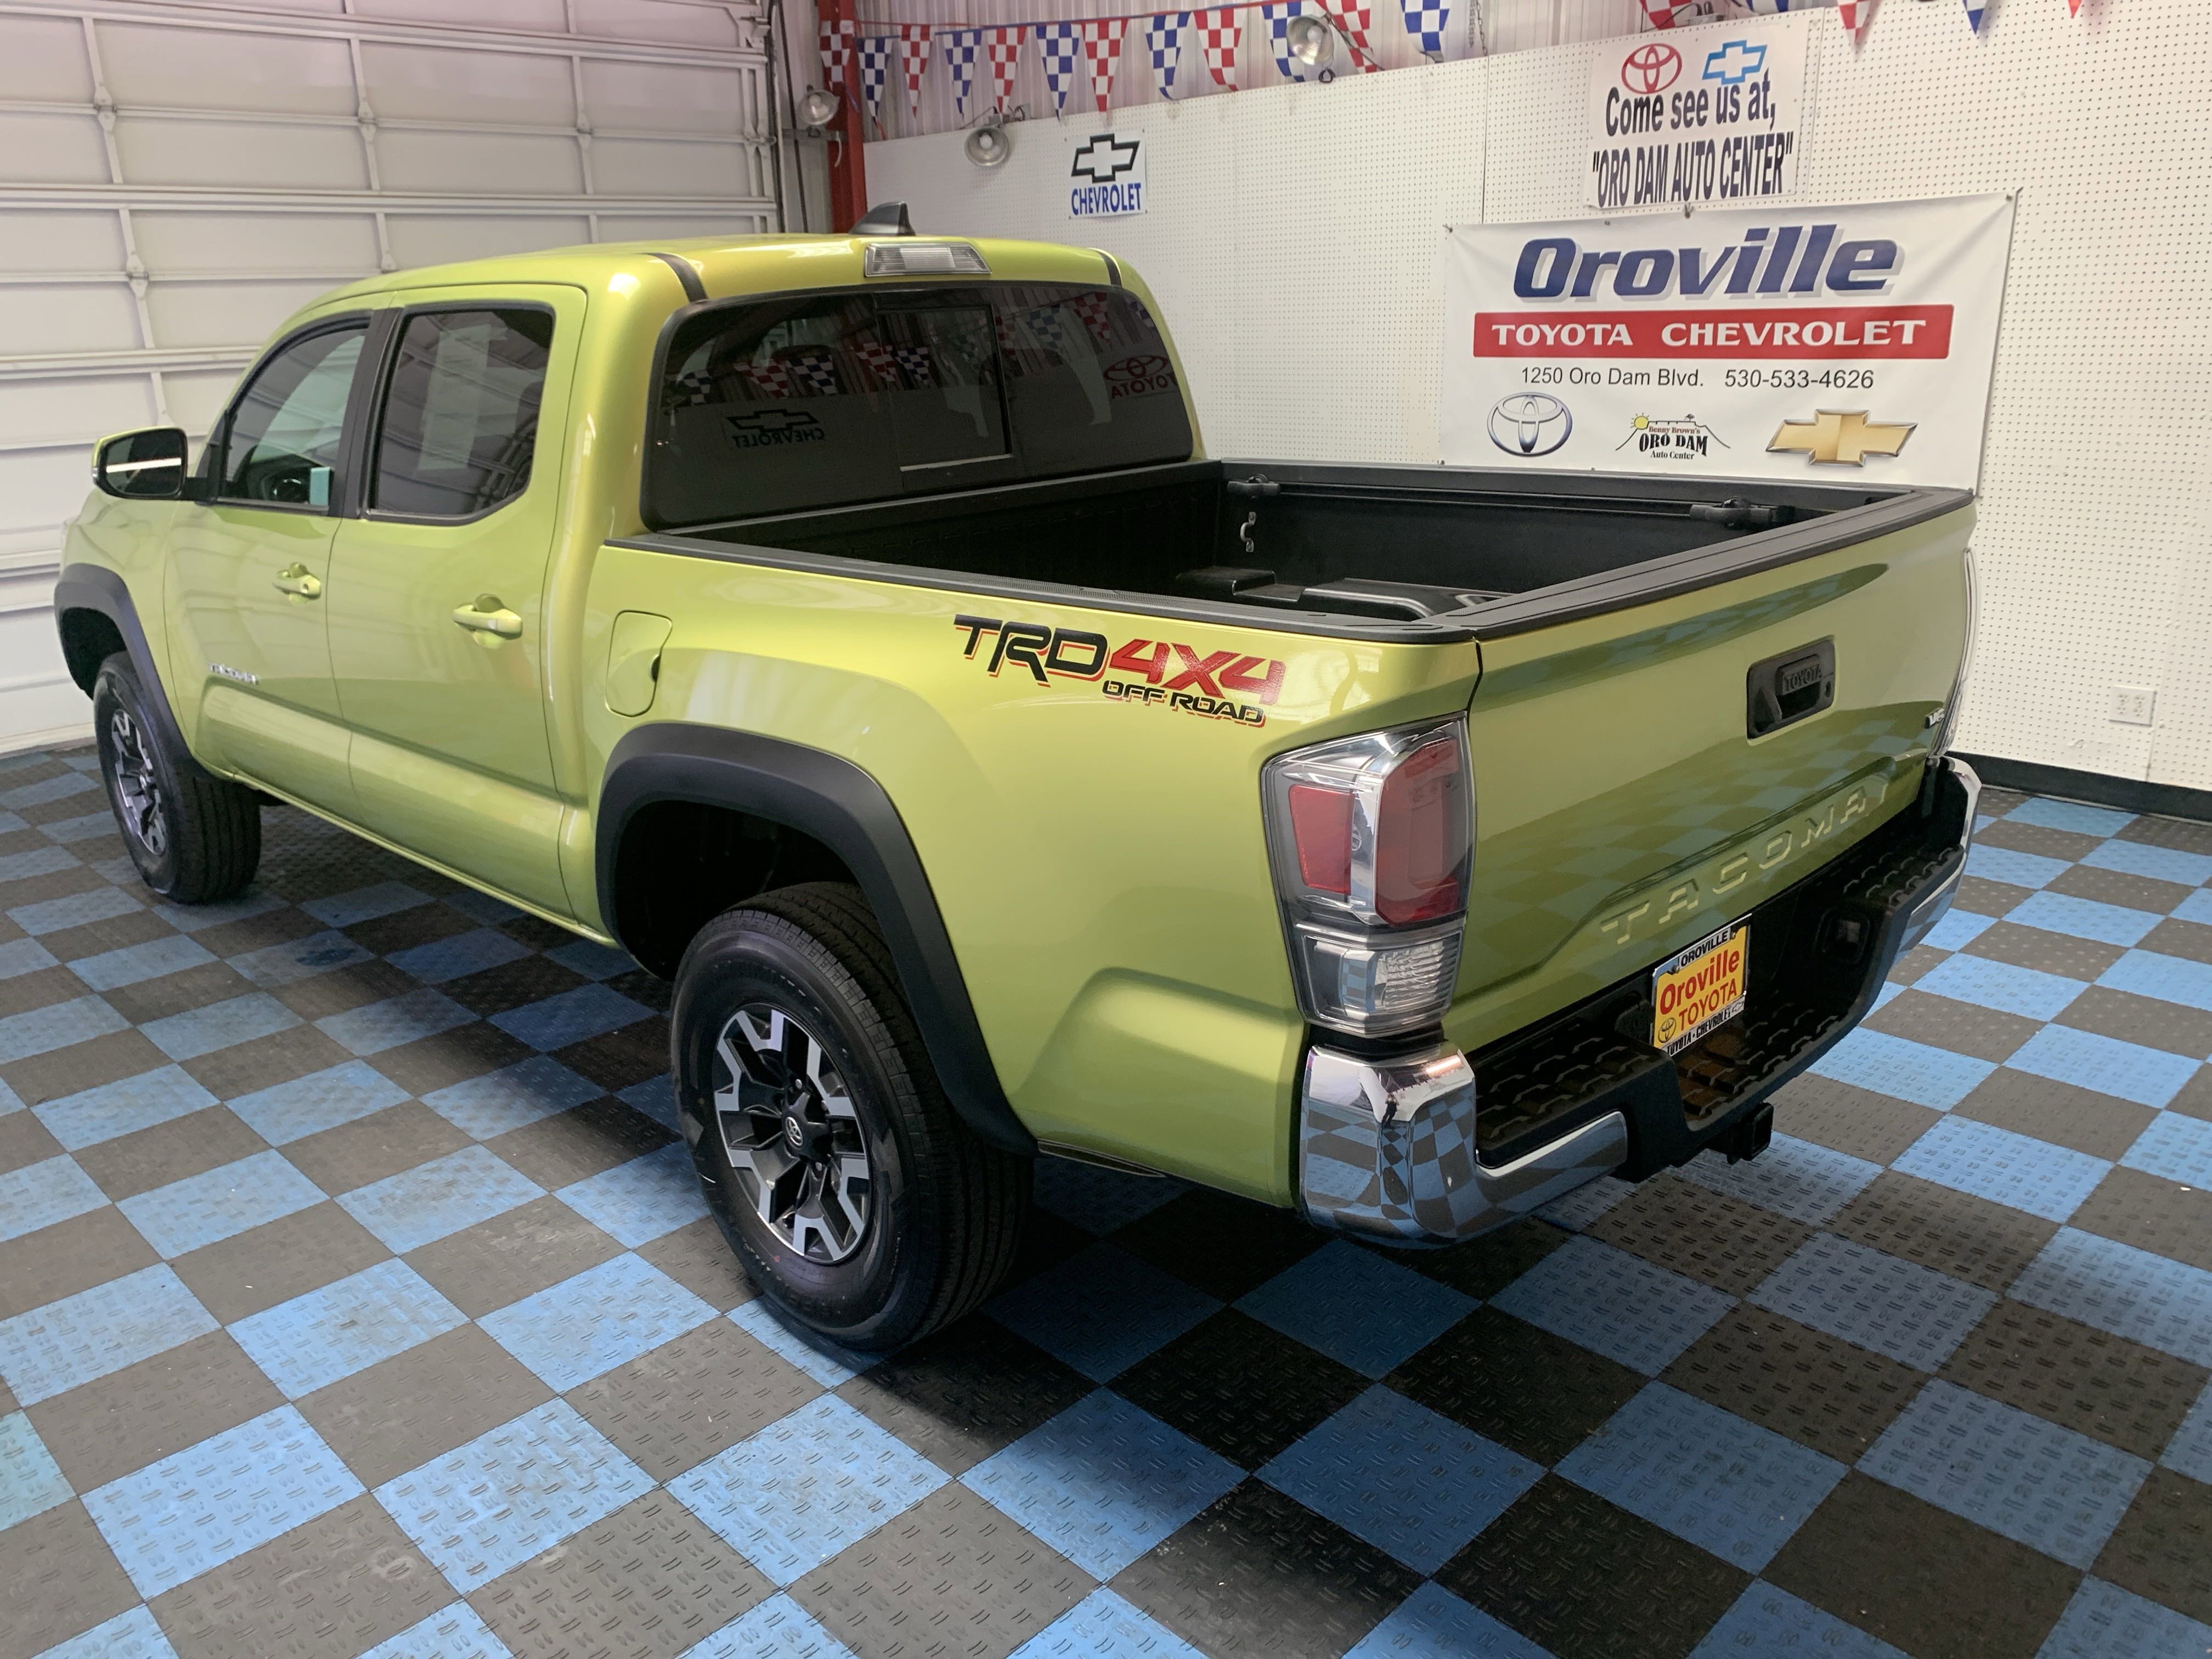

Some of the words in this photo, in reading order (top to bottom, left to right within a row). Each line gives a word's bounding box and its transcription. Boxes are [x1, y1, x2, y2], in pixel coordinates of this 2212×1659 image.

[1605, 87, 1664, 136] Come
[1671, 88, 1709, 129] see
[1716, 84, 1741, 125] us
[1748, 67, 1776, 131] at,
[1593, 147, 1630, 208] "ORO
[1634, 144, 1669, 204] DAM
[1671, 139, 1716, 202] AUTO
[1720, 131, 1794, 198] CENTER"
[1071, 183, 1141, 215] CHEVROLET
[1514, 224, 1901, 301] Oroville
[1492, 323, 1633, 346] TOYOTA
[1661, 320, 1926, 346] CHEVROLET
[1522, 367, 1563, 384] 1250
[1570, 368, 1601, 385] Oro
[1608, 368, 1650, 385] Dam
[1658, 369, 1703, 386] Blvd.
[1725, 369, 1874, 388] 530-533-4626
[1639, 433, 1671, 452] ORO
[1675, 435, 1708, 456] DAM
[1649, 426, 1670, 434] Benny
[1650, 450, 1668, 459] Auto
[1669, 451, 1695, 460] Center
[953, 614, 1110, 688] TRD
[1109, 638, 1286, 706] 4X4
[1782, 663, 1822, 692] TOYOTA
[1102, 680, 1167, 707] OFF
[1170, 692, 1267, 728] ROAD
[1600, 786, 1865, 944] TACOMA
[1681, 930, 1728, 967] OROVILLE
[1660, 949, 1740, 1015] Oroville
[1678, 978, 1737, 1031] TOYOTA
